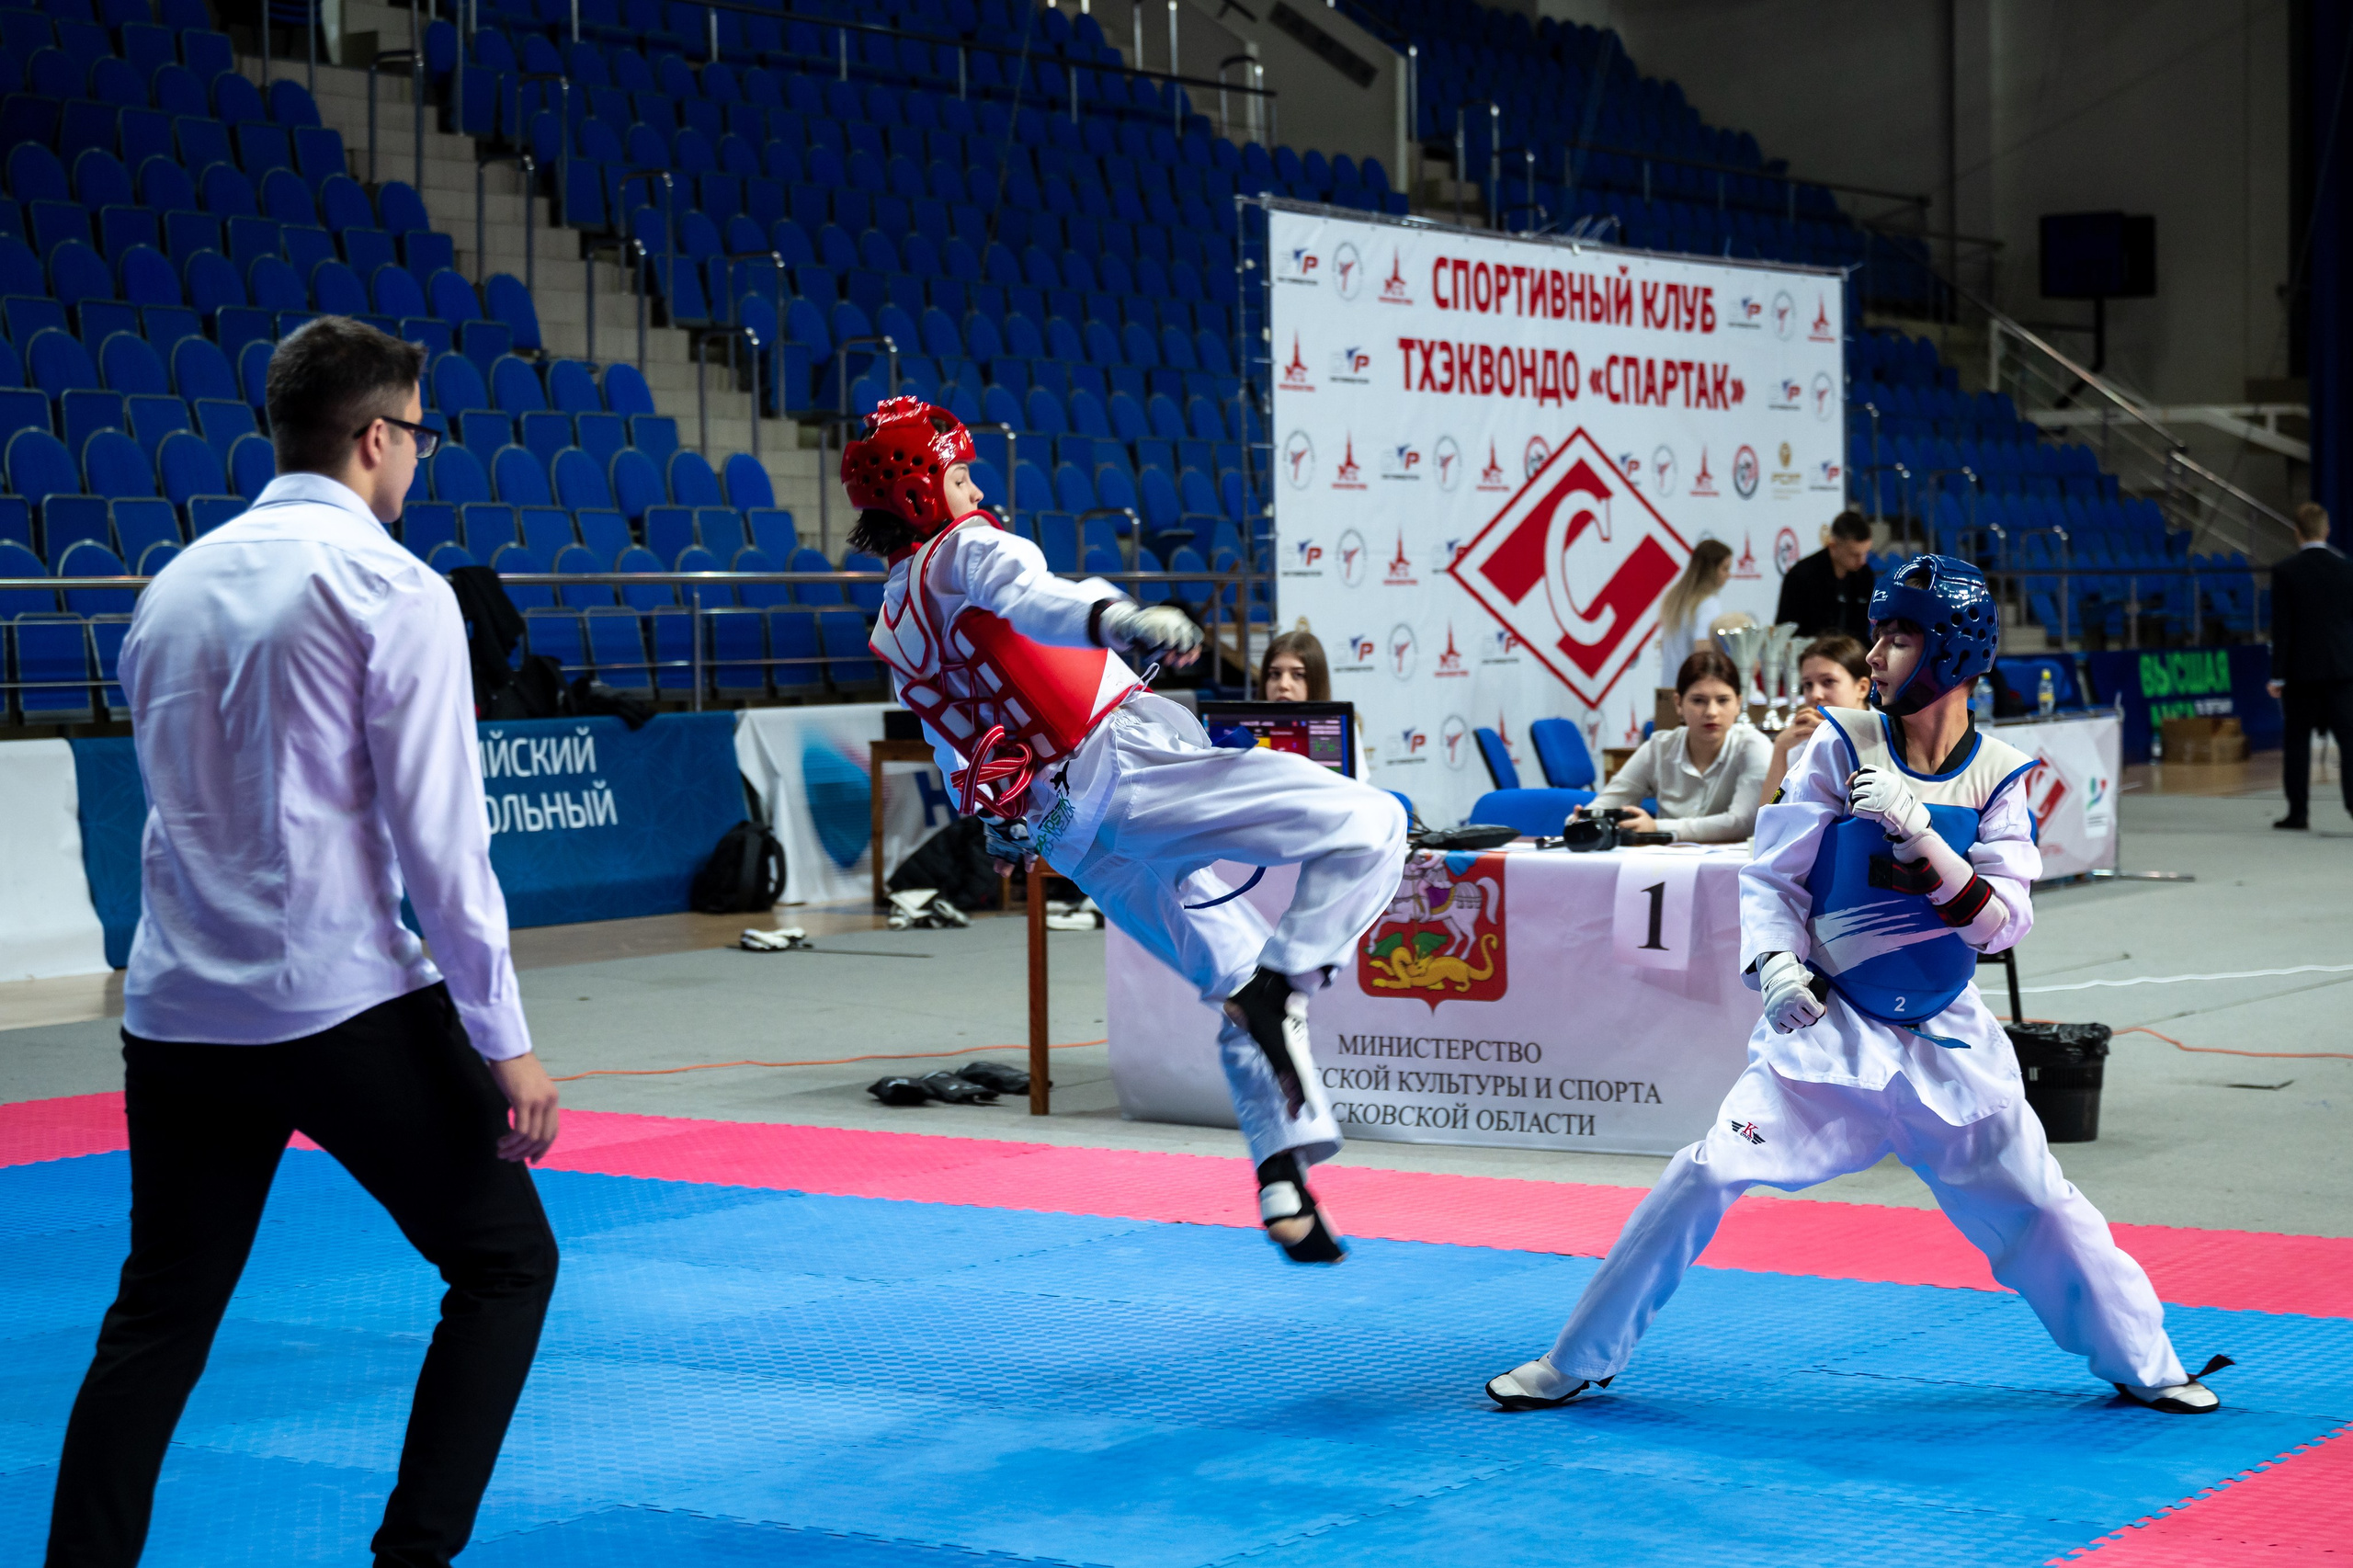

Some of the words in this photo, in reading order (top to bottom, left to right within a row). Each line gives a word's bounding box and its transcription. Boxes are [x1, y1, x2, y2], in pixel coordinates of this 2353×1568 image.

[1432, 256, 1632, 327] СПОРТИВНЫЙ
[1642, 279, 1717, 335] КЛУБ
[1398, 337, 1579, 407] ТХЭКВОНДО
[1588, 355, 1745, 411] «СПАРТАК»
[2140, 650, 2232, 698] ВЫСШАЯ
[1637, 881, 1670, 950] 1
[1894, 997, 1905, 1012] 2
[1338, 1034, 1541, 1063] МИНИСТЕРСТВО
[1398, 1071, 1528, 1096] КУЛЬТУРЫ
[1534, 1077, 1553, 1099] И
[1559, 1078, 1664, 1104] СПОРТА
[1476, 1109, 1596, 1136] ОБЛАСТИ
